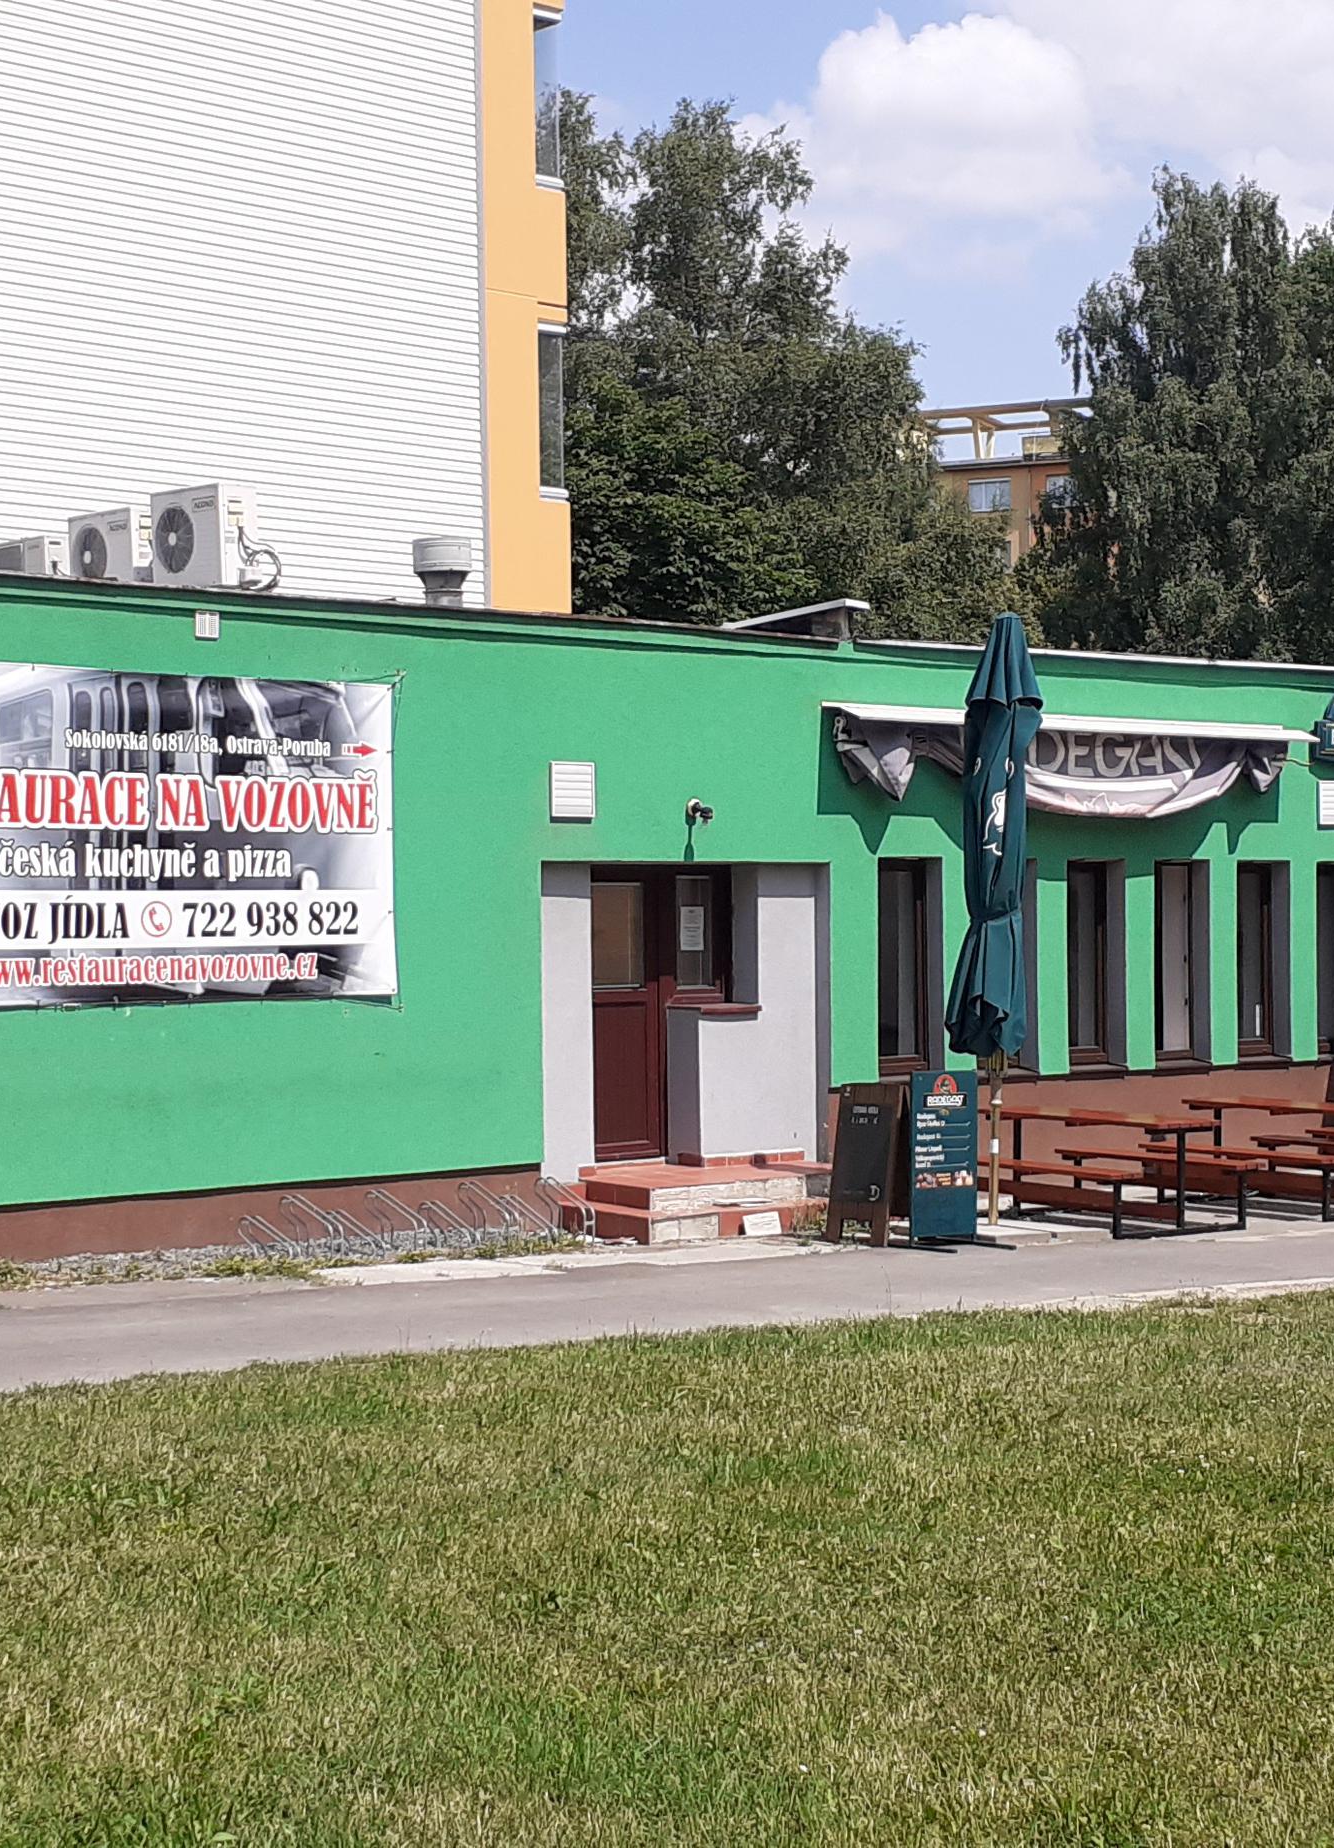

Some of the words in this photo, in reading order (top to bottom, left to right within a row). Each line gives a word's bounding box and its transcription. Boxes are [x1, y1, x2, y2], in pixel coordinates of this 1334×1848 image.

[65, 729, 148, 750] Sokolovská
[152, 732, 223, 755] 6181/18a,
[226, 735, 331, 757] Ostrava-Poruba
[159, 778, 207, 827] NA
[219, 774, 375, 829] VOZOVNĚ
[85, 842, 196, 882] kuchyně
[203, 849, 221, 878] a
[228, 845, 292, 882] pizza
[48, 894, 130, 944] JÍDLA
[182, 902, 236, 937] 722
[247, 901, 299, 937] 938
[308, 901, 359, 936] 822
